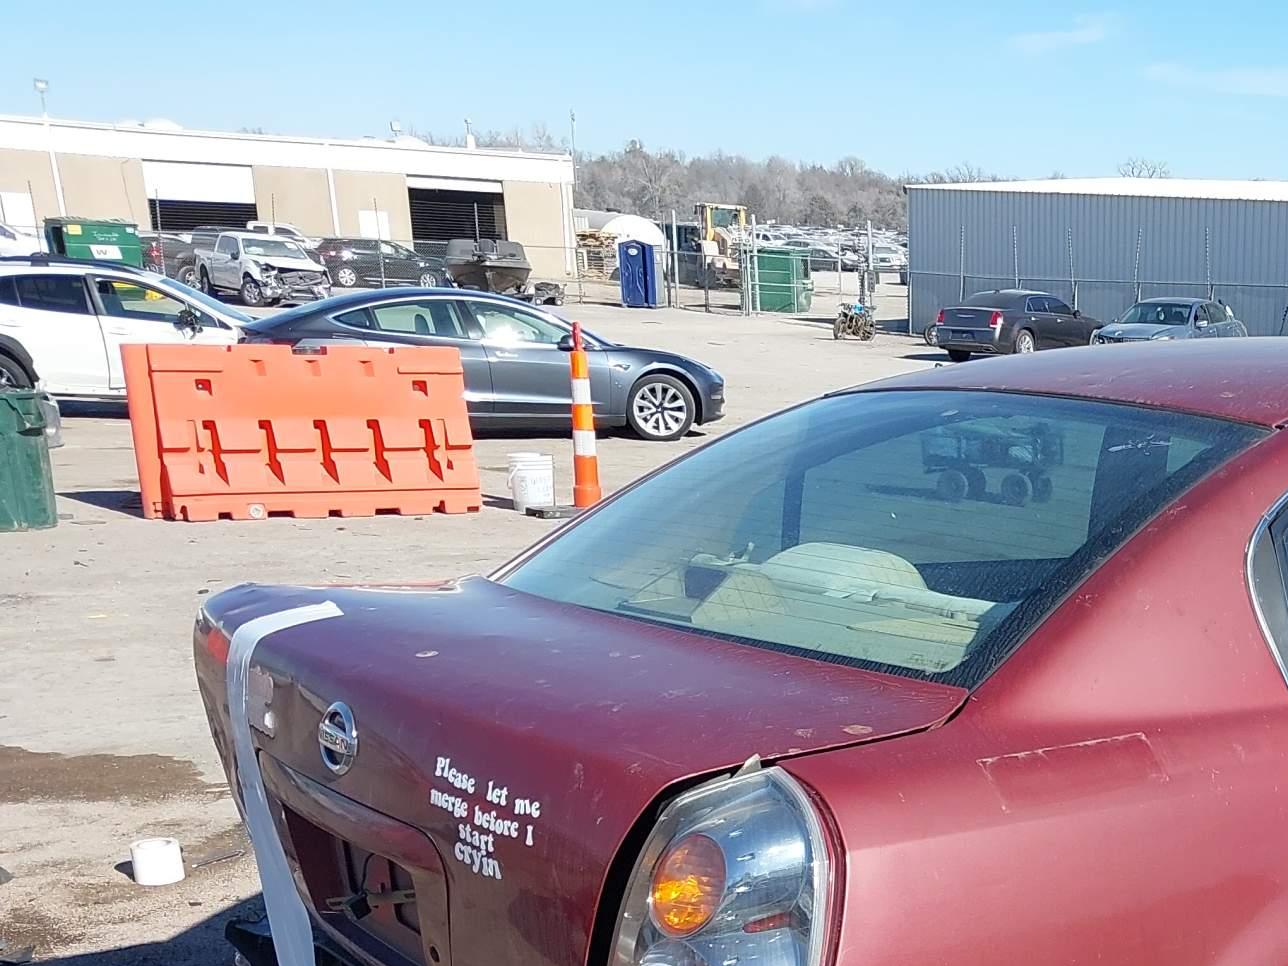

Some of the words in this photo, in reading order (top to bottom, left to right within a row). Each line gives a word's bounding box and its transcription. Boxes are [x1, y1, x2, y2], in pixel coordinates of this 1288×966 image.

[435, 756, 475, 794] Please
[486, 780, 508, 806] let
[514, 798, 540, 818] me
[430, 788, 468, 818] merge
[474, 805, 519, 838] before
[526, 825, 533, 846] I
[458, 823, 494, 852] start
[455, 841, 502, 880] cryin
